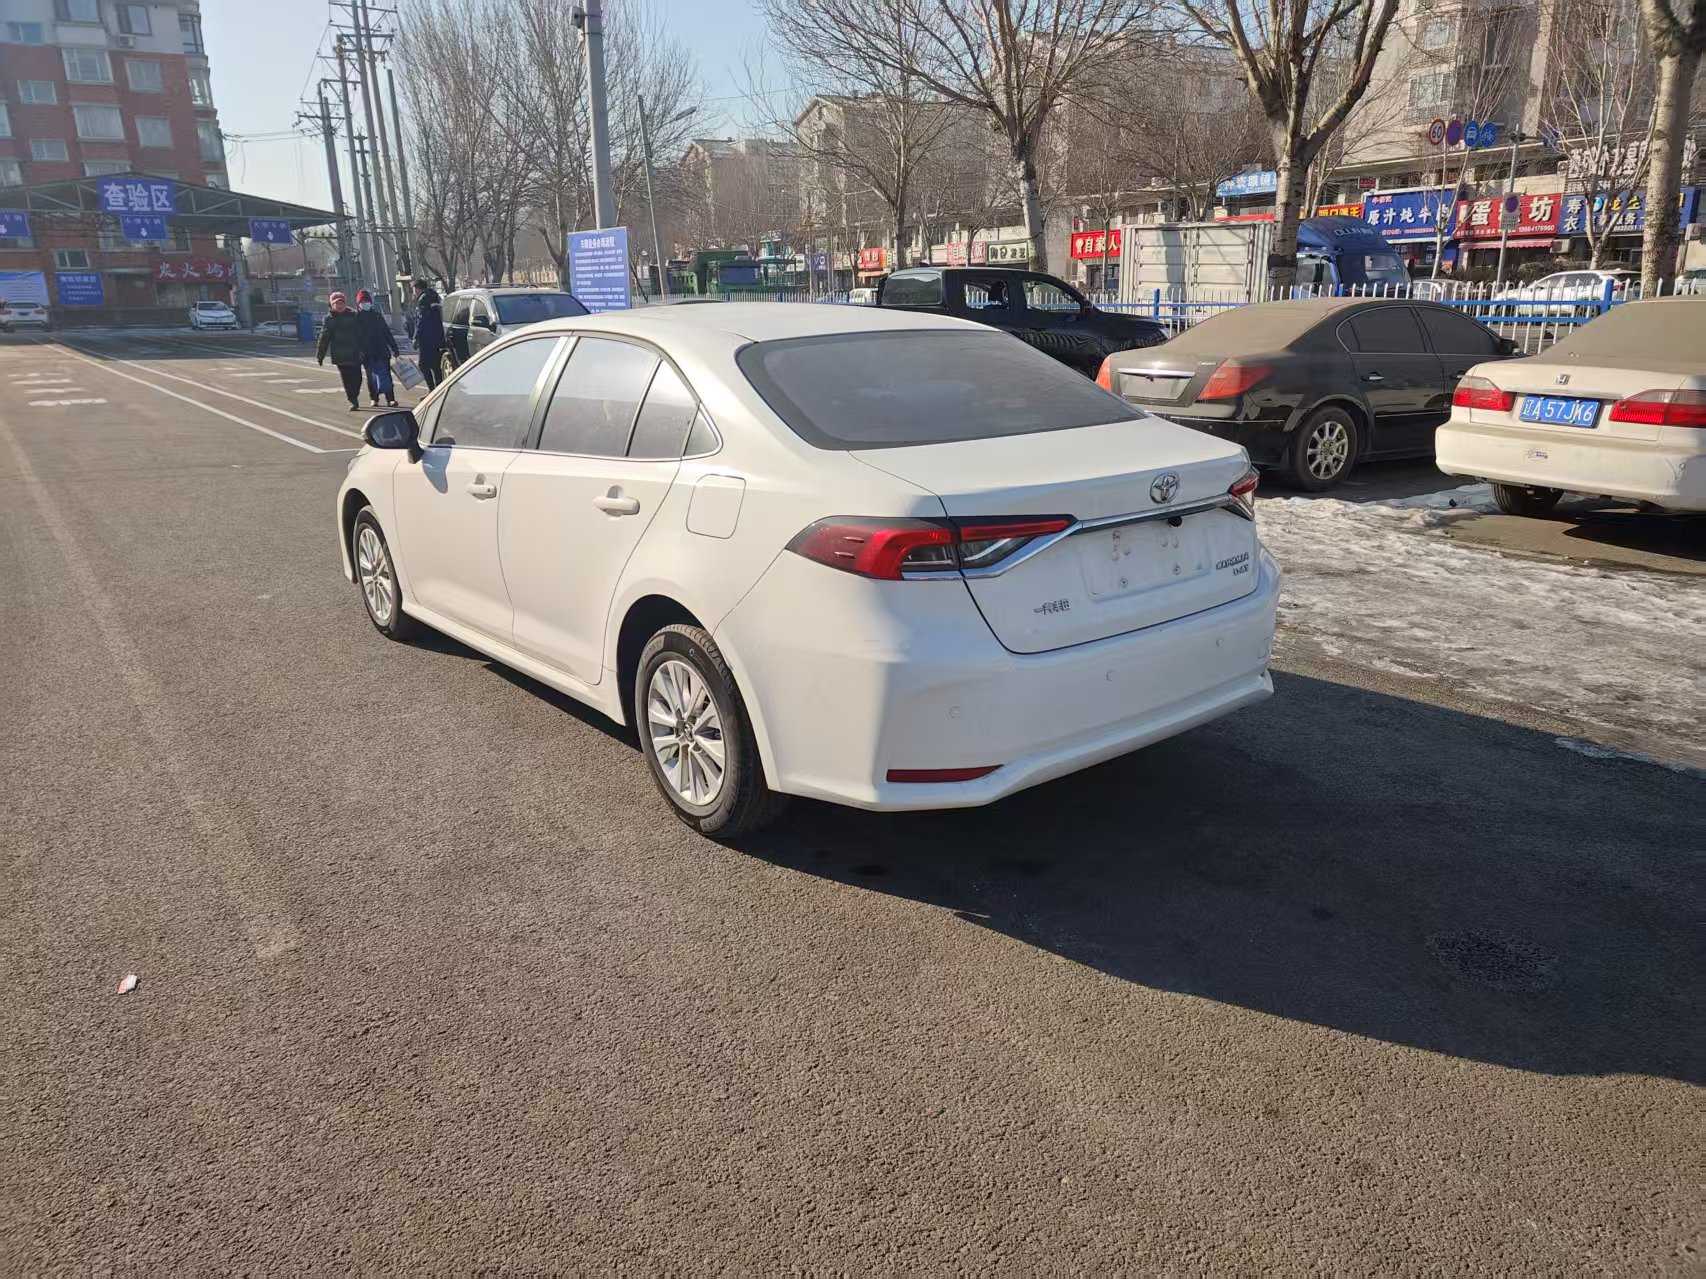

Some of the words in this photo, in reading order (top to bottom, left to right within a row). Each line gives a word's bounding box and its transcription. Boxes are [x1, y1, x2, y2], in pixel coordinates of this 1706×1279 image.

[103, 183, 173, 212] 查验区
[1471, 196, 1554, 226] 蛋坊
[1564, 198, 1582, 232] 寿衣
[1083, 234, 1119, 254] 自家人
